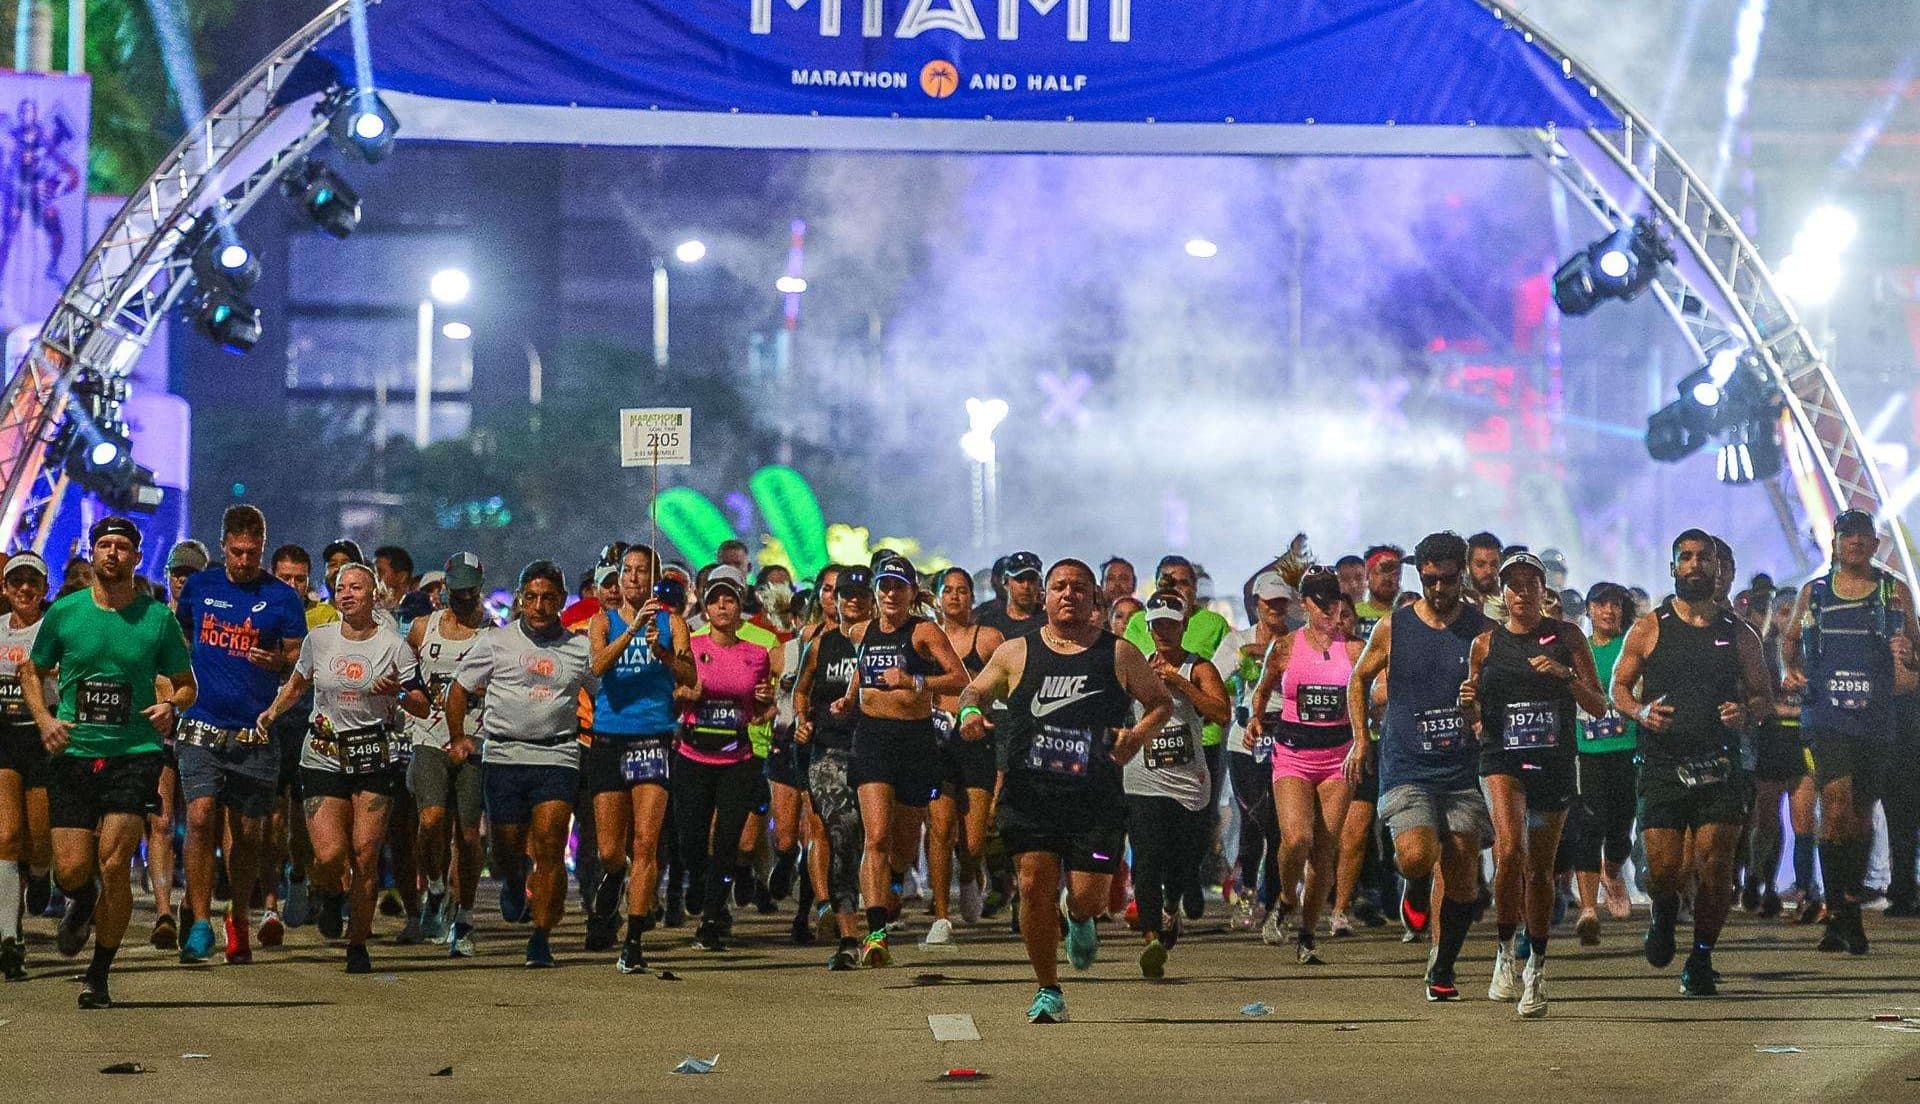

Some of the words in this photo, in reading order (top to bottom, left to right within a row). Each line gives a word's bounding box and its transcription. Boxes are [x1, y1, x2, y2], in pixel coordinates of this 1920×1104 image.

[791, 69, 908, 89] MARATHON
[969, 73, 1017, 91] AND
[1027, 74, 1088, 92] HALF
[647, 432, 680, 447] 2:05
[866, 655, 898, 667] 17531
[1040, 674, 1089, 698] NIKE
[1829, 679, 1870, 692] 22958
[86, 691, 119, 705] 1428
[1306, 694, 1338, 705] 3853
[1422, 717, 1464, 731] 13330
[1509, 712, 1554, 725] 19743
[348, 742, 380, 757] 3486
[1035, 734, 1085, 754] 23096
[1151, 736, 1184, 750] 3968
